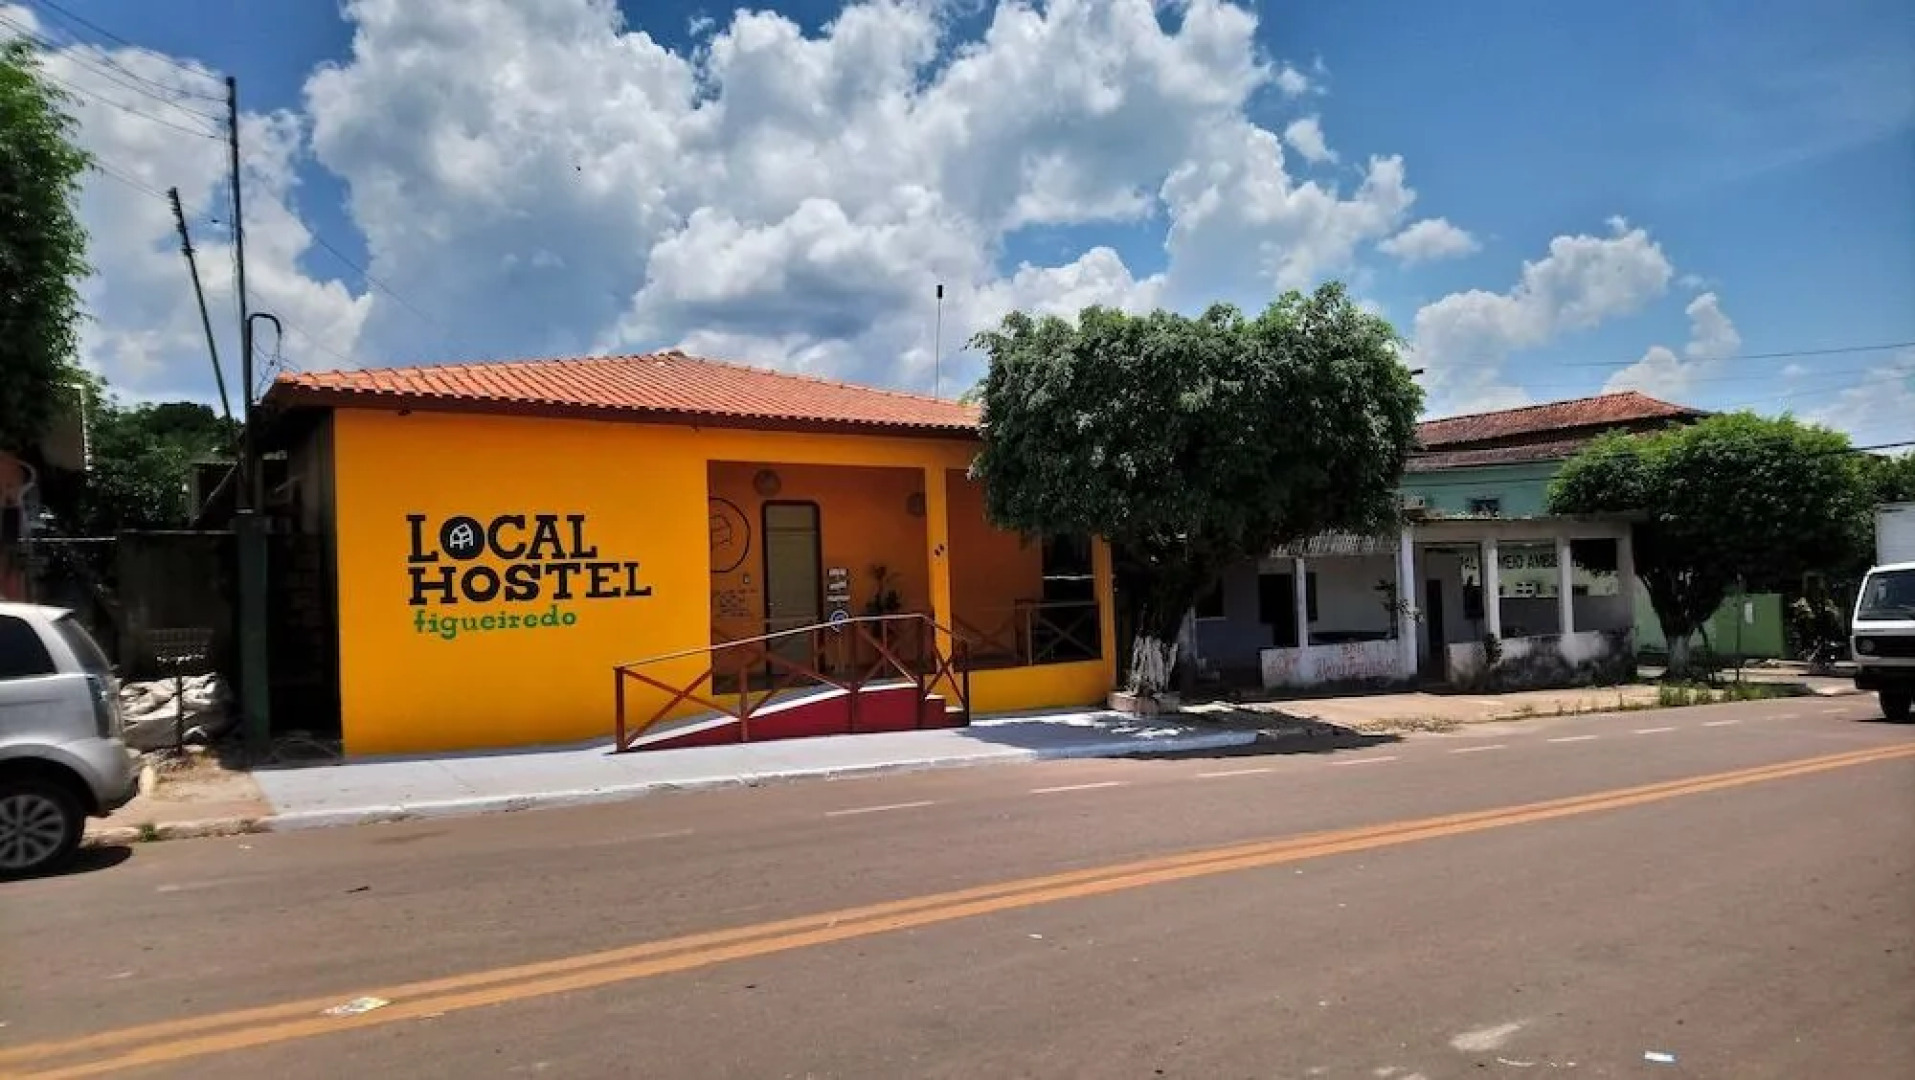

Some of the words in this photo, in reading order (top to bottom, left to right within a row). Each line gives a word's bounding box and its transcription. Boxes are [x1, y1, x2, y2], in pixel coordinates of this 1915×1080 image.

[406, 514, 598, 563] LOCAL
[407, 562, 652, 605] HOSTEL
[413, 604, 577, 640] figueiredo
